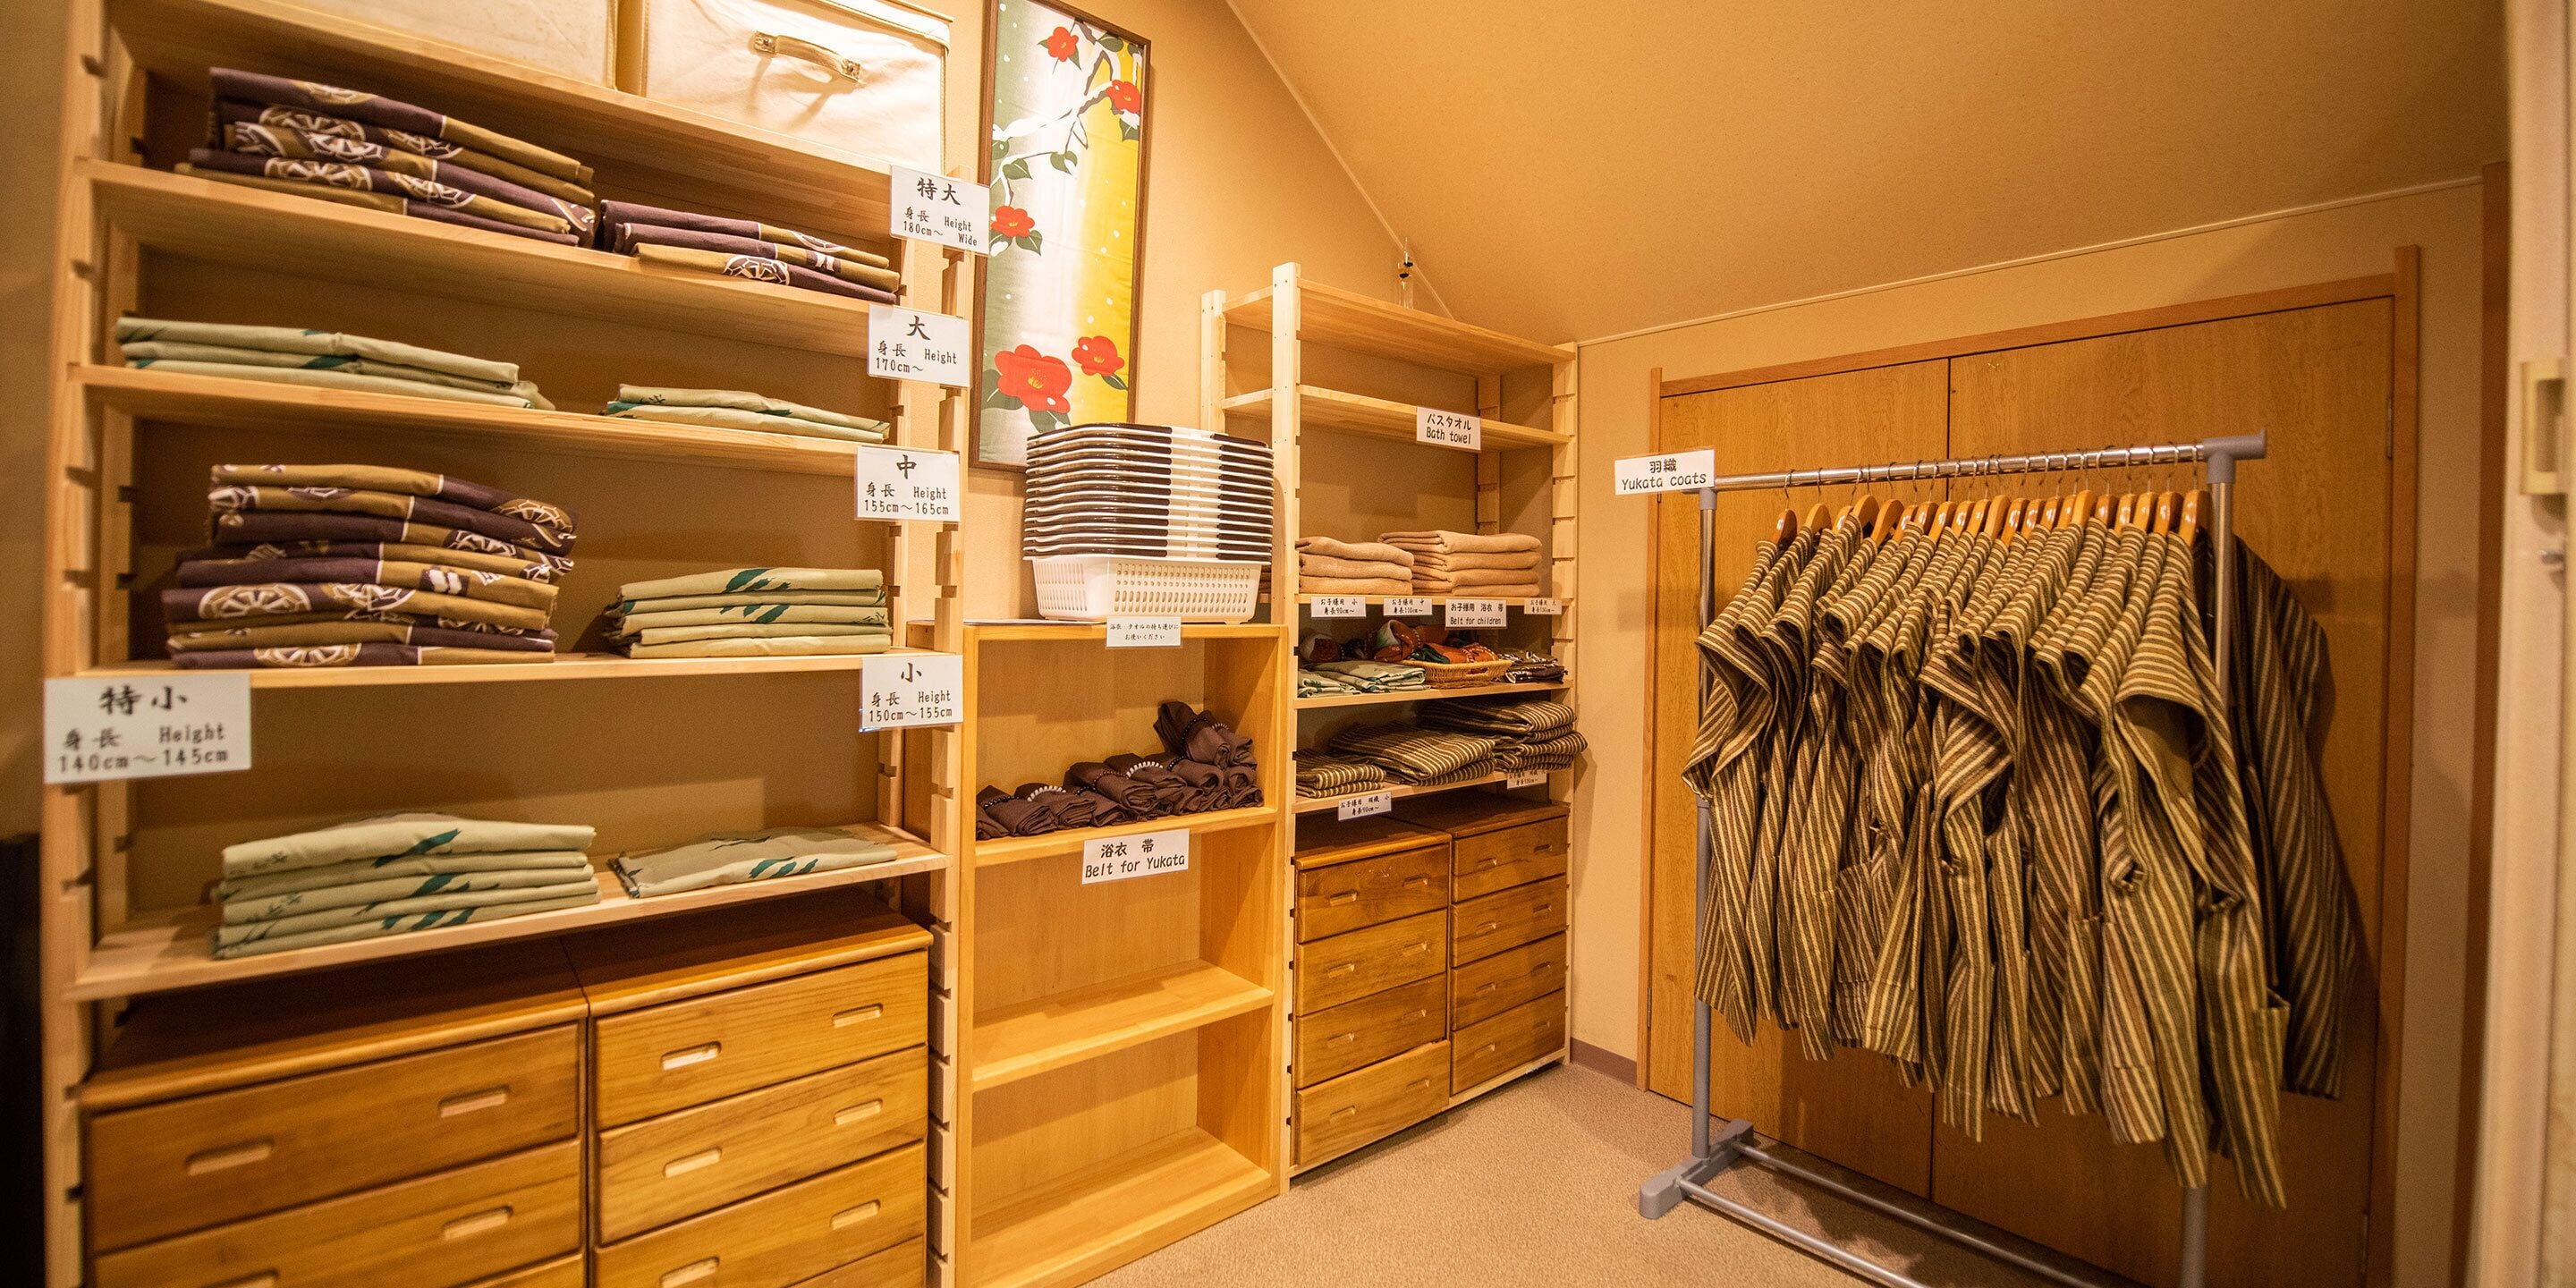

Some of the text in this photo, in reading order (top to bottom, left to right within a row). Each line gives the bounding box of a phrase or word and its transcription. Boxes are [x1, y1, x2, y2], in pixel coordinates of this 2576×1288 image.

[917, 177, 961, 206] 特大
[904, 206, 972, 233] 身長 Height
[958, 233, 978, 246] Wide
[906, 315, 931, 341] 大
[877, 339, 957, 365] 身長 Height
[1426, 426, 1471, 445] Bath towel
[896, 453, 917, 479] 中
[1648, 457, 1677, 474] 羽織
[866, 481, 947, 501] 身長 Height
[1622, 472, 1707, 491] Yukata coats
[1451, 602, 1475, 612] お子様用
[1480, 603, 1493, 612] 浴衣
[1450, 616, 1502, 625] Belt for children
[900, 662, 922, 683] 小
[98, 684, 189, 716] 特小
[870, 690, 952, 708] 身長 Height
[63, 722, 225, 751] 身長 Height
[1100, 837, 1155, 859] 浴衣 帯
[1085, 853, 1185, 878] Belt for Yukata
